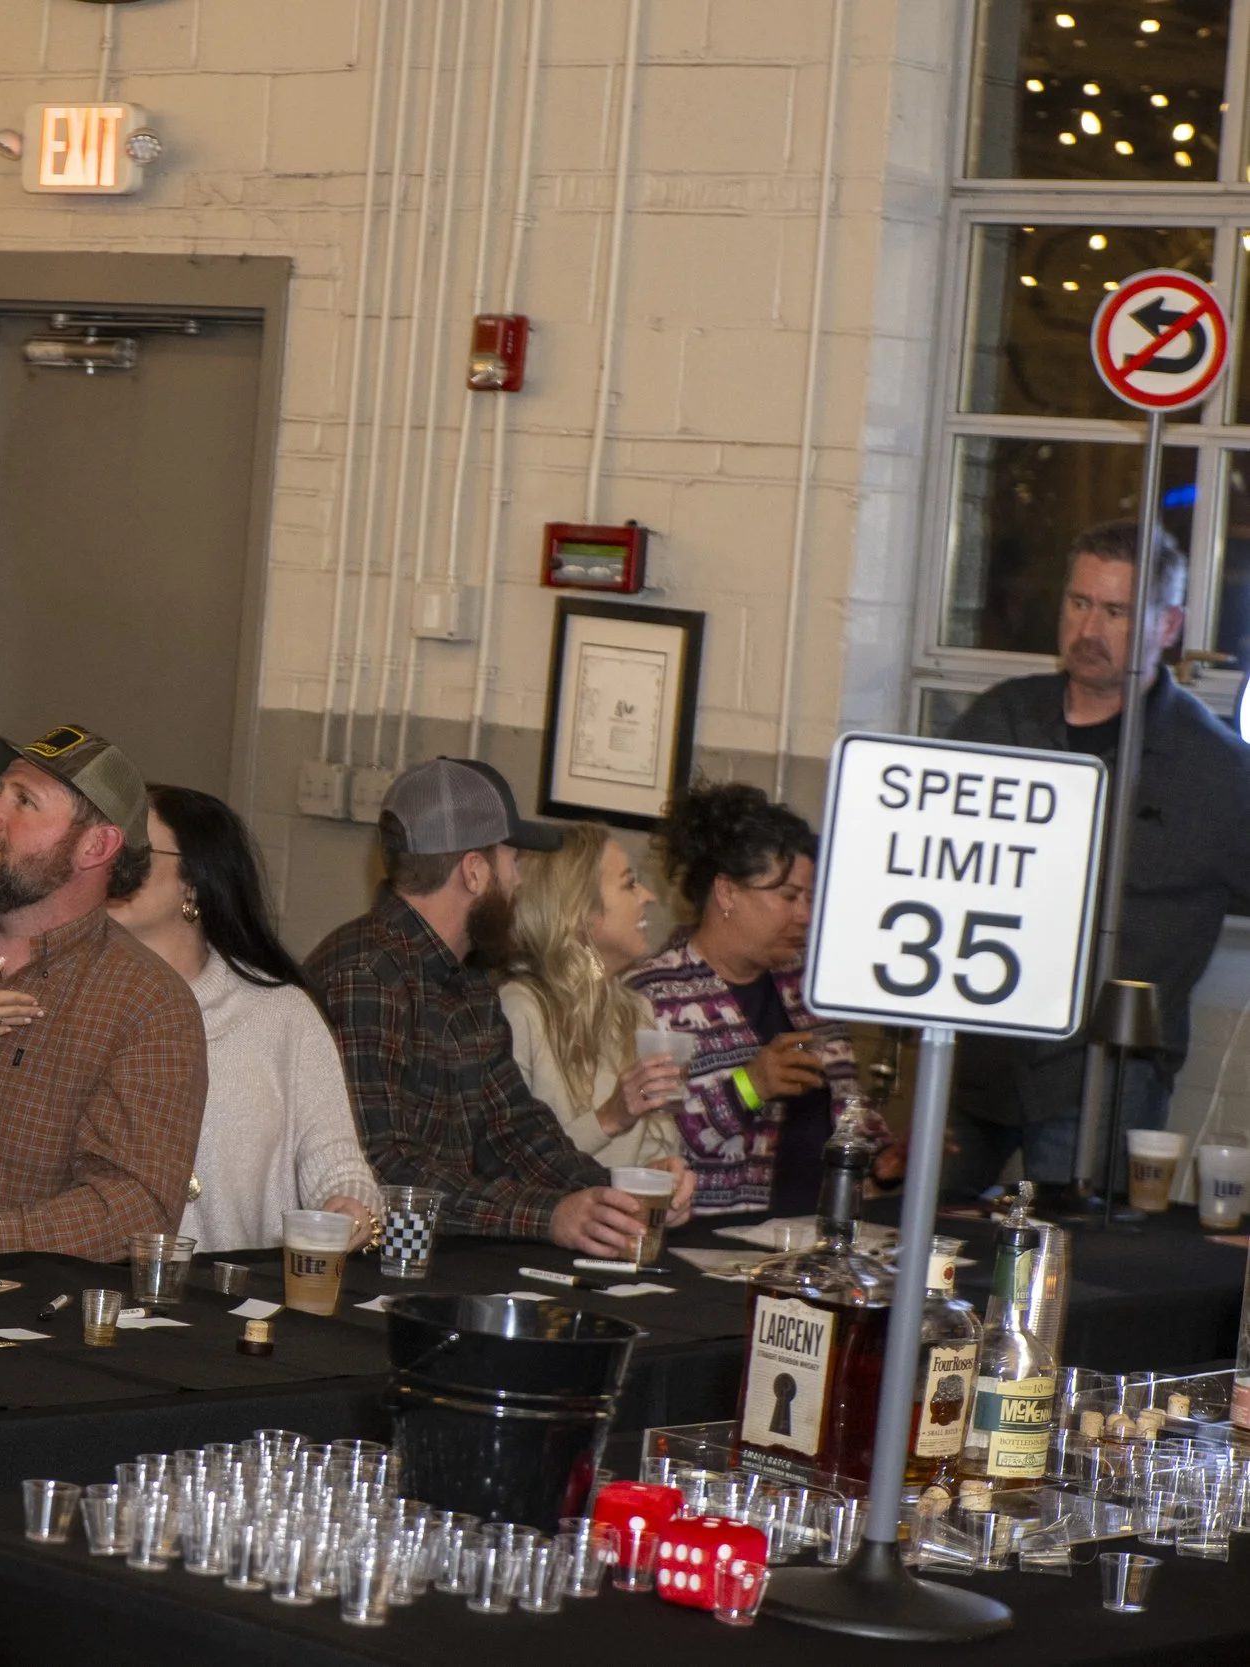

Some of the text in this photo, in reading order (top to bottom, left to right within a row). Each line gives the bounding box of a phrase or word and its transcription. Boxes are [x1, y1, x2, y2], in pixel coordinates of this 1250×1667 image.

[40, 107, 123, 186] EXIT
[878, 763, 1057, 825] SPEED
[885, 831, 1037, 888] LIMIT
[873, 899, 1023, 1006] 35
[1214, 1179, 1244, 1198] Lite
[289, 1252, 326, 1278] Lite
[758, 1310, 824, 1357] LARCENY
